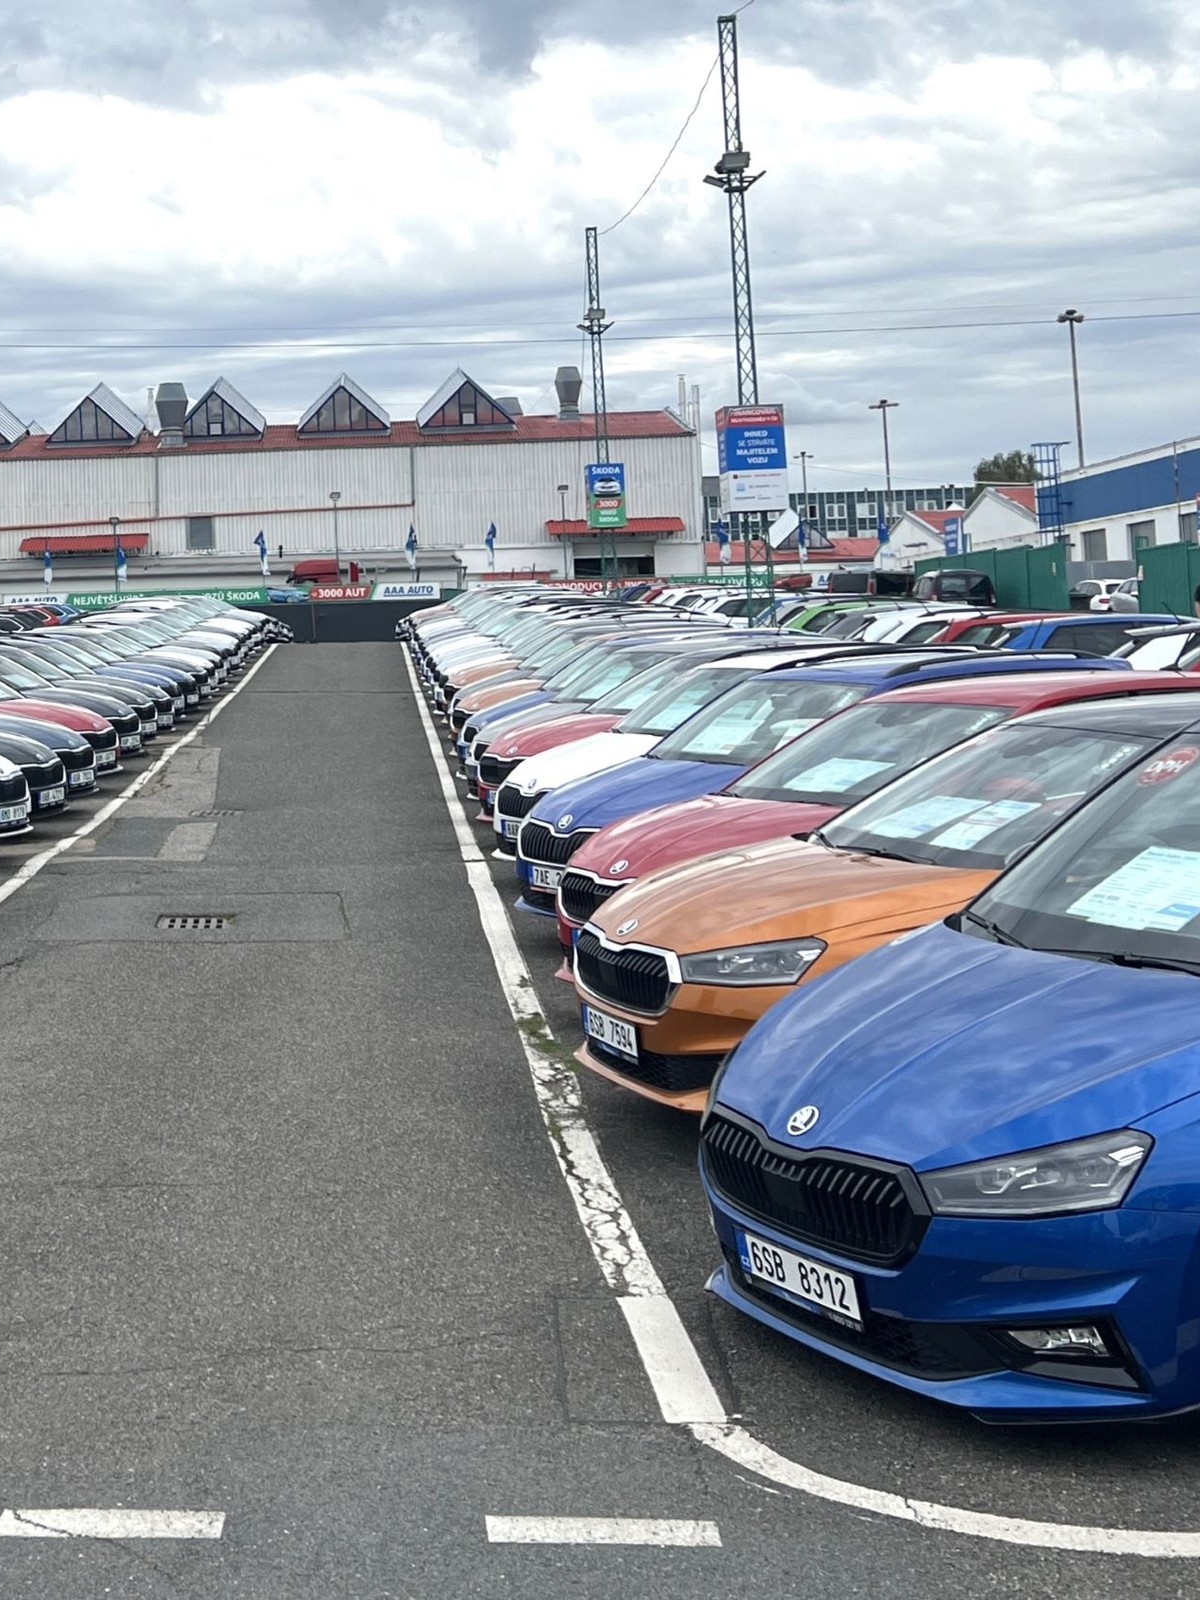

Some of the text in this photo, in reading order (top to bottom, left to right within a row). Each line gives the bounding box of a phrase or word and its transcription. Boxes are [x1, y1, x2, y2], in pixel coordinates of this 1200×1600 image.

[744, 430, 768, 438] IHNED
[736, 447, 778, 456] MAJITELEM
[592, 466, 620, 474] ŠKODA
[318, 588, 343, 598] 3000
[345, 587, 366, 597] AUT
[383, 585, 434, 594] AAA AUTO
[202, 591, 224, 600] OZŮ
[226, 591, 260, 600] ŠKODA
[1144, 760, 1189, 773] DPH
[534, 868, 550, 886] 7AE
[751, 1241, 786, 1283] 6SB
[798, 1261, 851, 1312] 8312
